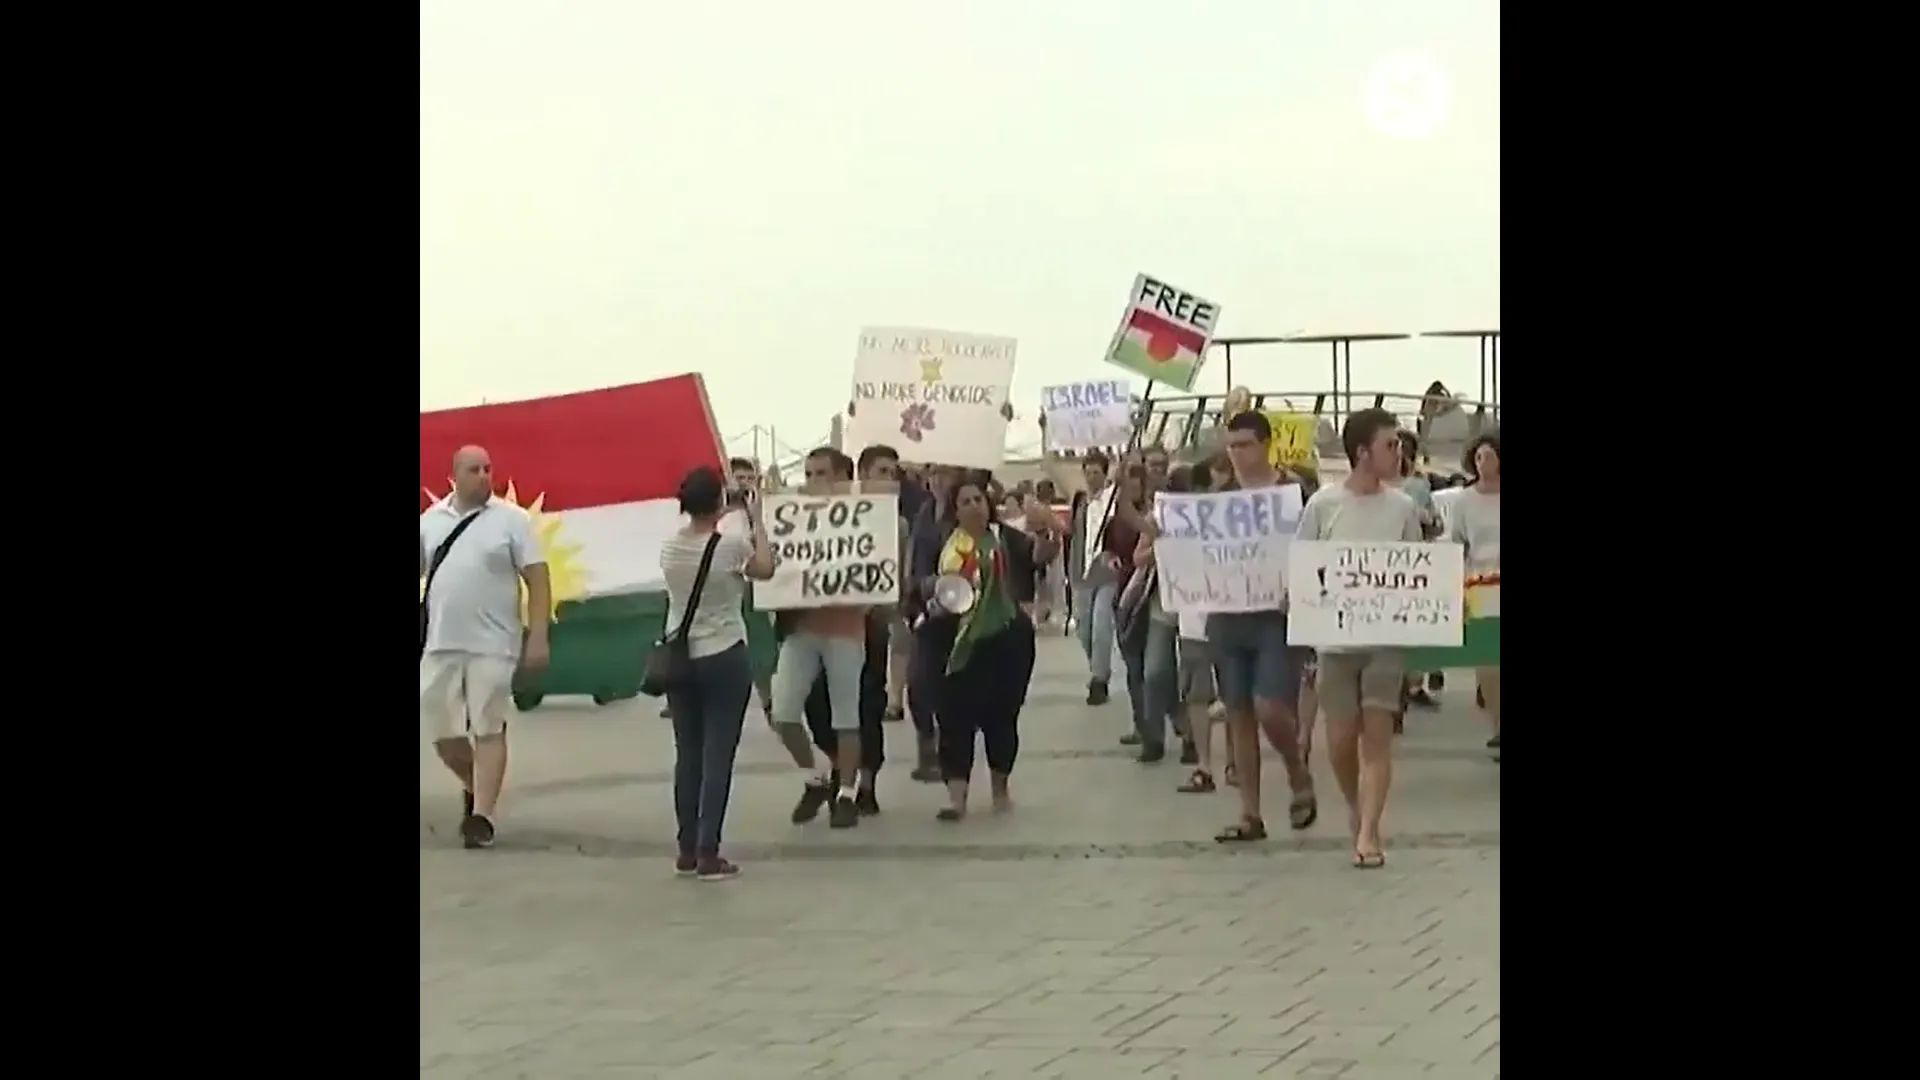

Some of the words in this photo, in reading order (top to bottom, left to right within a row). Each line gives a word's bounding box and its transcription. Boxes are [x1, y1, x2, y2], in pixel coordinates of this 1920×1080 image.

[1139, 278, 1213, 330] FREE
[856, 381, 876, 400] NO
[881, 380, 917, 402] MORE
[923, 383, 997, 406] GENOCIDE
[1046, 380, 1129, 411] ISRAEL
[773, 501, 873, 536] STOP
[1156, 493, 1298, 541] ISRAEL
[769, 532, 875, 566] BOMBING
[802, 558, 896, 598] KURDS
